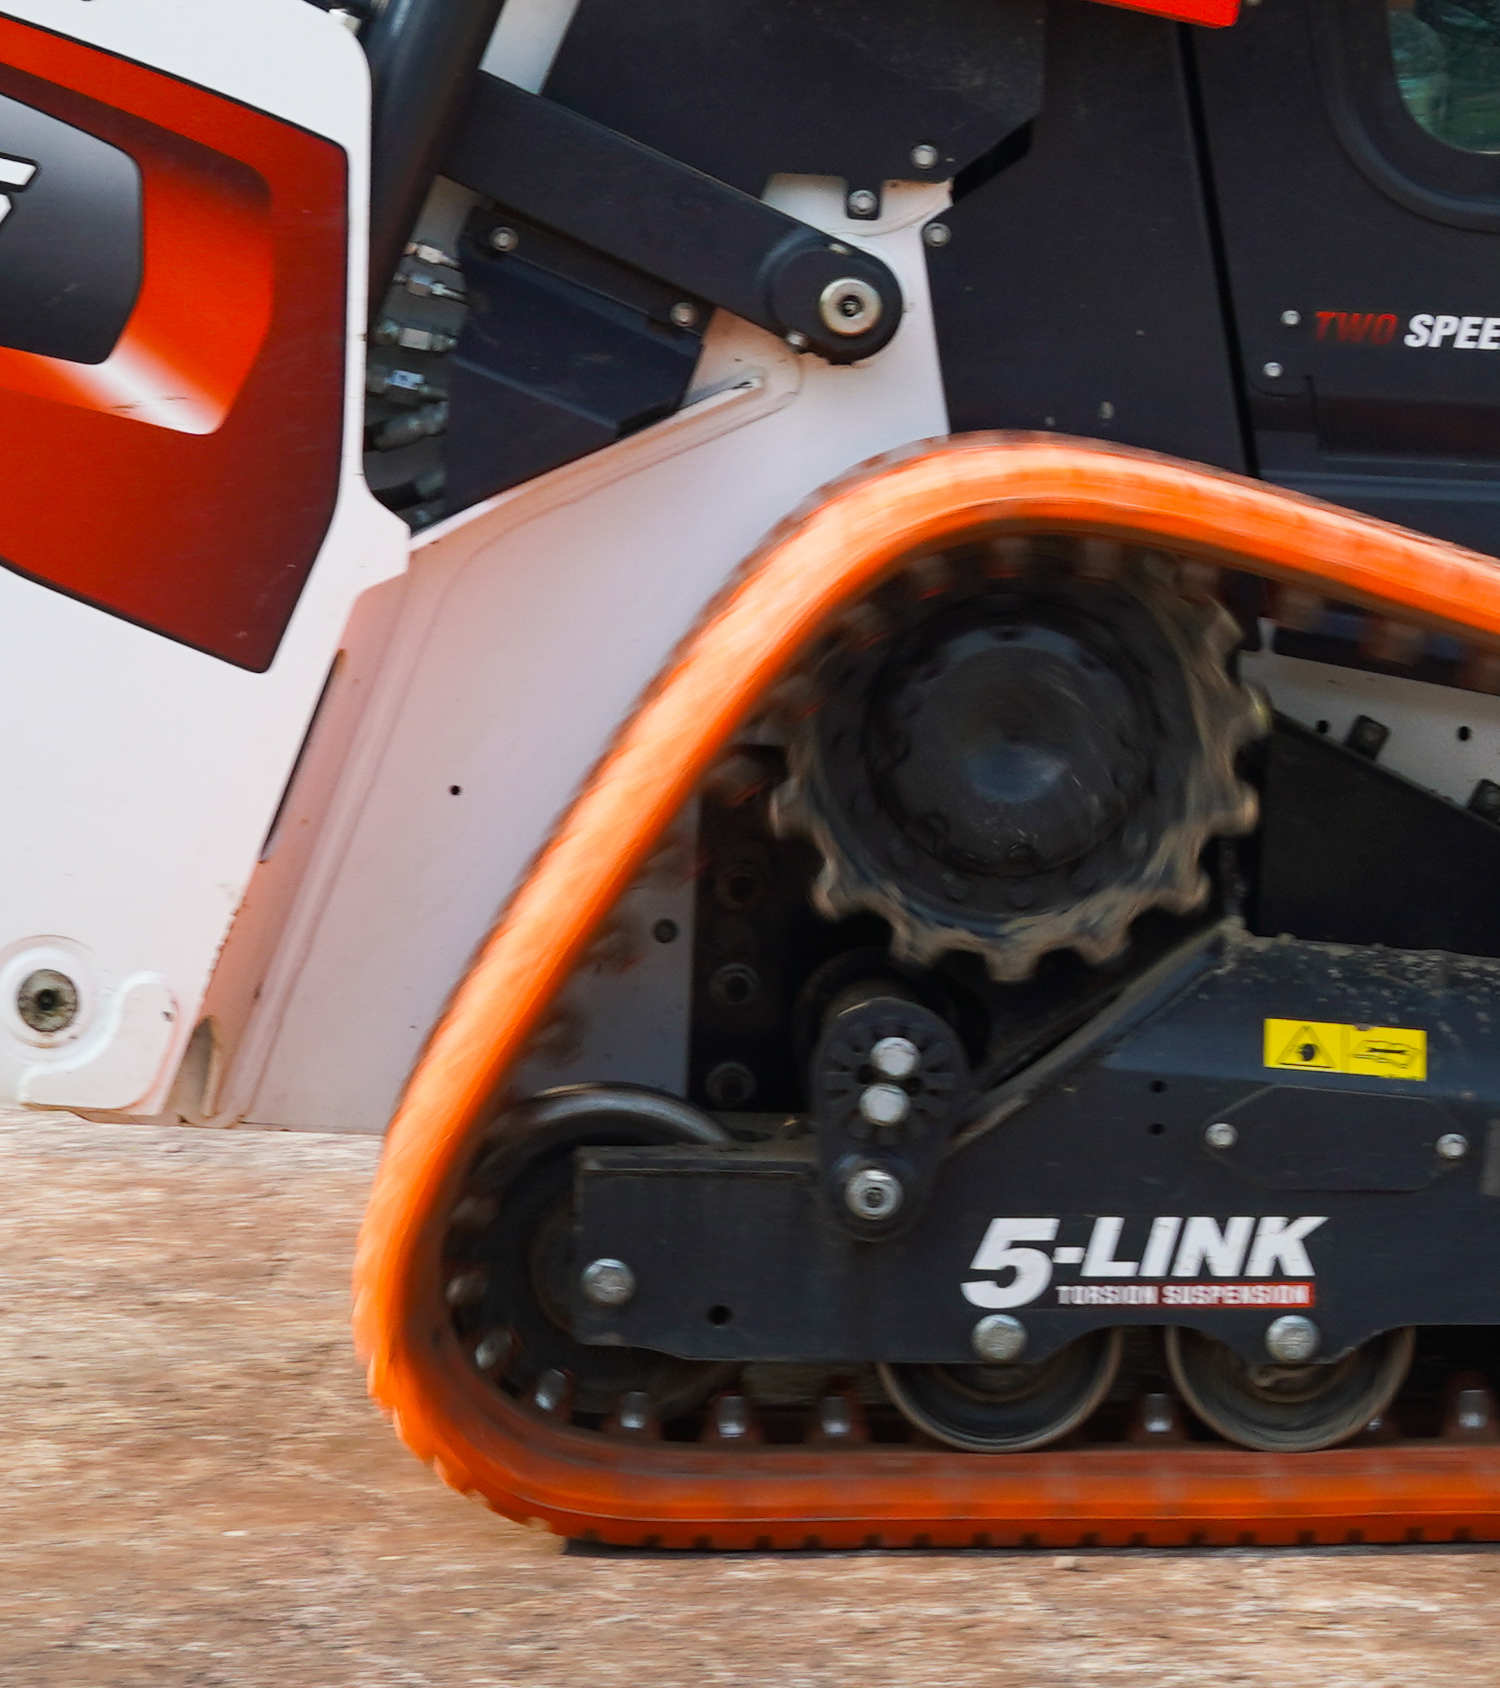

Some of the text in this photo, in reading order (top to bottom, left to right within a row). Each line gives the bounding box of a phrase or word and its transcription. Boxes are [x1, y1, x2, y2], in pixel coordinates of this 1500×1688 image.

[1315, 311, 1398, 345] TWO
[960, 1216, 1329, 1309] 5-LINK
[1056, 1284, 1311, 1305] TORSION SUSPENSION
